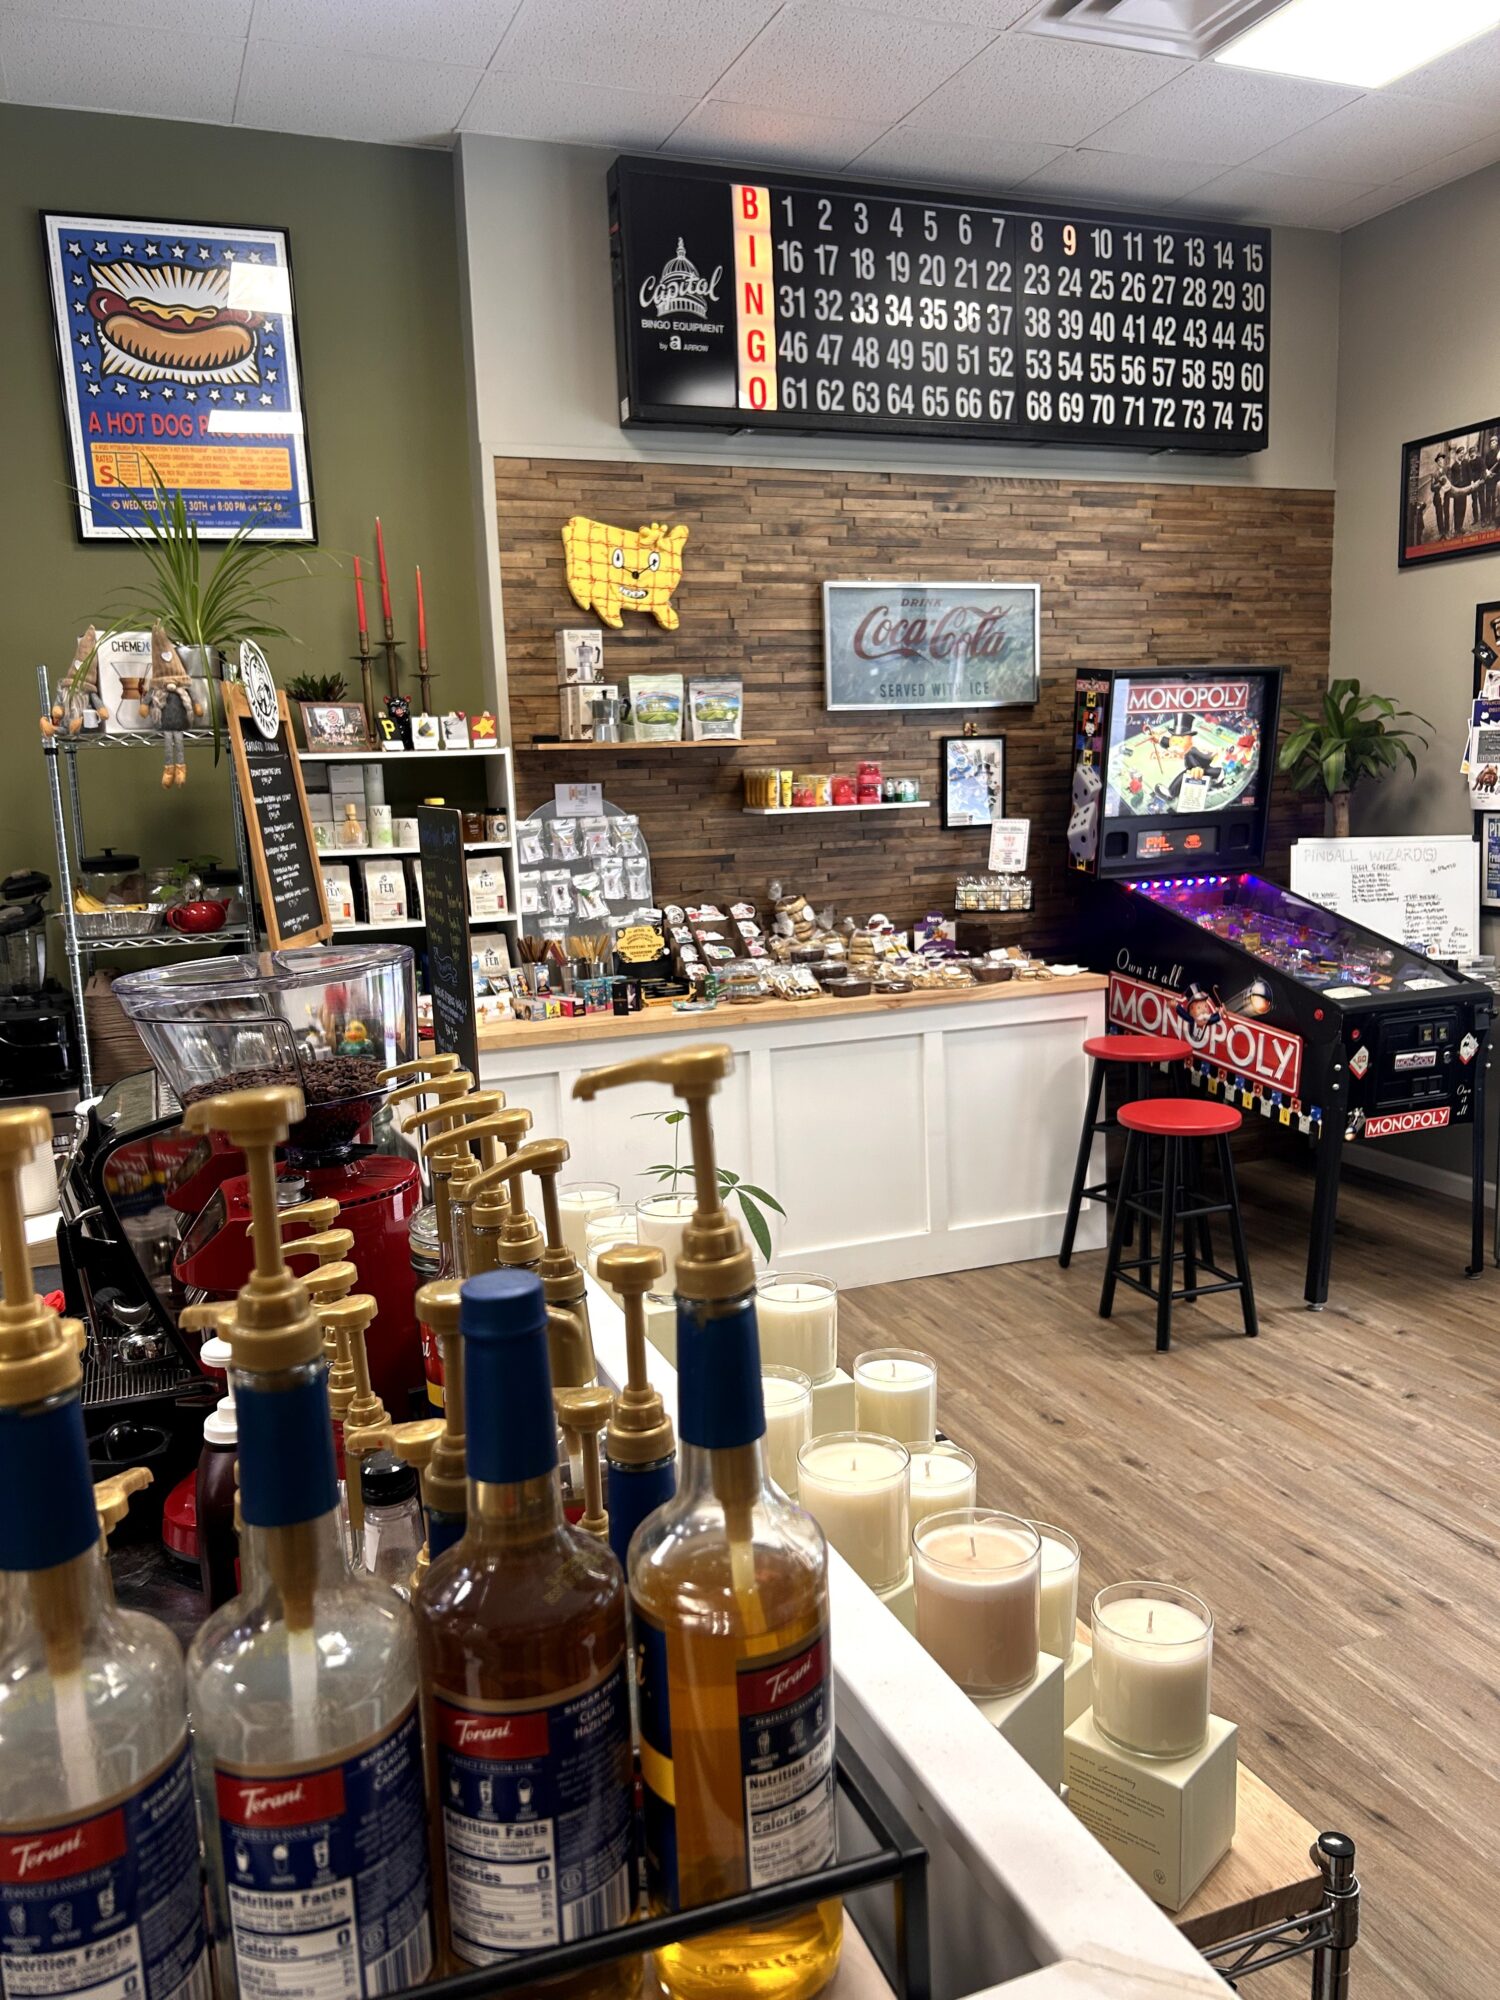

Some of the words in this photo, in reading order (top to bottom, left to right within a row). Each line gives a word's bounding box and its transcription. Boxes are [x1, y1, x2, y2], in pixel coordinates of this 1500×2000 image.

[782, 196, 793, 227] 1
[818, 199, 832, 231] 2
[854, 203, 868, 234] 3
[889, 207, 903, 238] 4
[924, 210, 938, 241] 5
[959, 214, 972, 245] 6
[992, 217, 1005, 248] 7
[1030, 221, 1043, 253] 8
[1063, 225, 1076, 256] 9
[1090, 228, 1112, 259] 10
[1123, 232, 1142, 261] 11
[1153, 235, 1174, 264] 12
[1184, 238, 1205, 267] 13
[1214, 241, 1234, 270] 14
[1243, 244, 1263, 272] 15
[777, 240, 803, 273] 16
[814, 244, 838, 276] 17
[850, 248, 875, 280] 18
[886, 251, 910, 283] 19
[918, 253, 946, 287] 20
[954, 257, 978, 289] 21
[986, 260, 1012, 293] 22
[1023, 263, 1051, 295] 23
[1057, 266, 1083, 298] 24
[1090, 269, 1114, 300] 25
[1121, 271, 1146, 303] 26
[1152, 274, 1176, 305] 27
[1183, 277, 1206, 307] 28
[1212, 280, 1235, 310] 29
[1242, 282, 1265, 312] 30
[641, 319, 671, 330] BINGO
[672, 321, 725, 334] EQUIPMENT
[780, 285, 805, 318] 31
[814, 288, 844, 322] 32
[850, 291, 880, 325] 33
[884, 293, 914, 328] 34
[919, 295, 948, 331] 35
[953, 299, 981, 334] 36
[986, 303, 1013, 336] 37
[1024, 305, 1051, 339] 38
[1057, 308, 1083, 340] 39
[1089, 312, 1115, 342] 40
[1122, 314, 1145, 344] 41
[1152, 316, 1176, 346] 42
[1183, 318, 1207, 348] 43
[1212, 321, 1236, 350] 44
[1241, 323, 1264, 352] 45
[778, 330, 808, 364] 46
[816, 333, 843, 366] 47
[851, 336, 880, 369] 48
[886, 338, 914, 371] 49
[921, 340, 949, 374] 50
[956, 343, 980, 376] 51
[988, 346, 1014, 378] 52
[1026, 348, 1052, 380] 53
[1058, 350, 1084, 382] 54
[1090, 353, 1115, 384] 55
[1121, 355, 1146, 386] 56
[1152, 357, 1176, 387] 57
[1182, 359, 1206, 389] 58
[1212, 361, 1235, 390] 59
[1241, 362, 1264, 392] 60
[782, 376, 807, 409] 61
[816, 378, 845, 411] 62
[852, 381, 880, 414] 63
[887, 382, 915, 415] 64
[921, 385, 950, 417] 65
[955, 386, 983, 419] 66
[989, 389, 1015, 420] 67
[1026, 390, 1052, 422] 68
[1058, 392, 1084, 423] 69
[1090, 394, 1115, 425] 70
[1122, 396, 1144, 426] 71
[1152, 397, 1176, 427] 72
[1182, 399, 1205, 429] 73
[1212, 401, 1234, 430] 74
[1241, 403, 1263, 432] 75
[88, 411, 102, 434] A
[107, 411, 146, 435] HOT
[151, 413, 194, 438] DOG
[95, 454, 114, 464] RATED
[99, 465, 114, 485] S
[234, 501, 247, 512] PM
[901, 598, 942, 608] DRINK
[879, 683, 926, 698] SERVED
[969, 681, 990, 696] ICE
[1129, 686, 1246, 710] MONOPOLY
[1304, 848, 1358, 862] PINBALL
[1117, 948, 1142, 972] Own
[1147, 962, 1157, 980] it
[1161, 964, 1182, 988] all
[1367, 1110, 1448, 1135] MONOPOLY
[766, 1653, 812, 1704] Torani
[454, 1719, 513, 1744] Torani
[750, 1762, 805, 1790] Nutrition
[239, 1782, 304, 1819] Torani
[506, 1824, 549, 1838] Facts
[752, 1806, 808, 1835] Calories
[11, 1829, 83, 1877] Torani
[537, 1864, 550, 1881] 0
[230, 1889, 295, 1910] Nutrition
[301, 1886, 348, 1908] Facts
[237, 1935, 299, 1958] Calories
[336, 1929, 351, 1947] 0
[3, 1954, 78, 1972] Nutrition
[85, 1934, 133, 1963] Facts
[123, 1975, 139, 1995] 0
